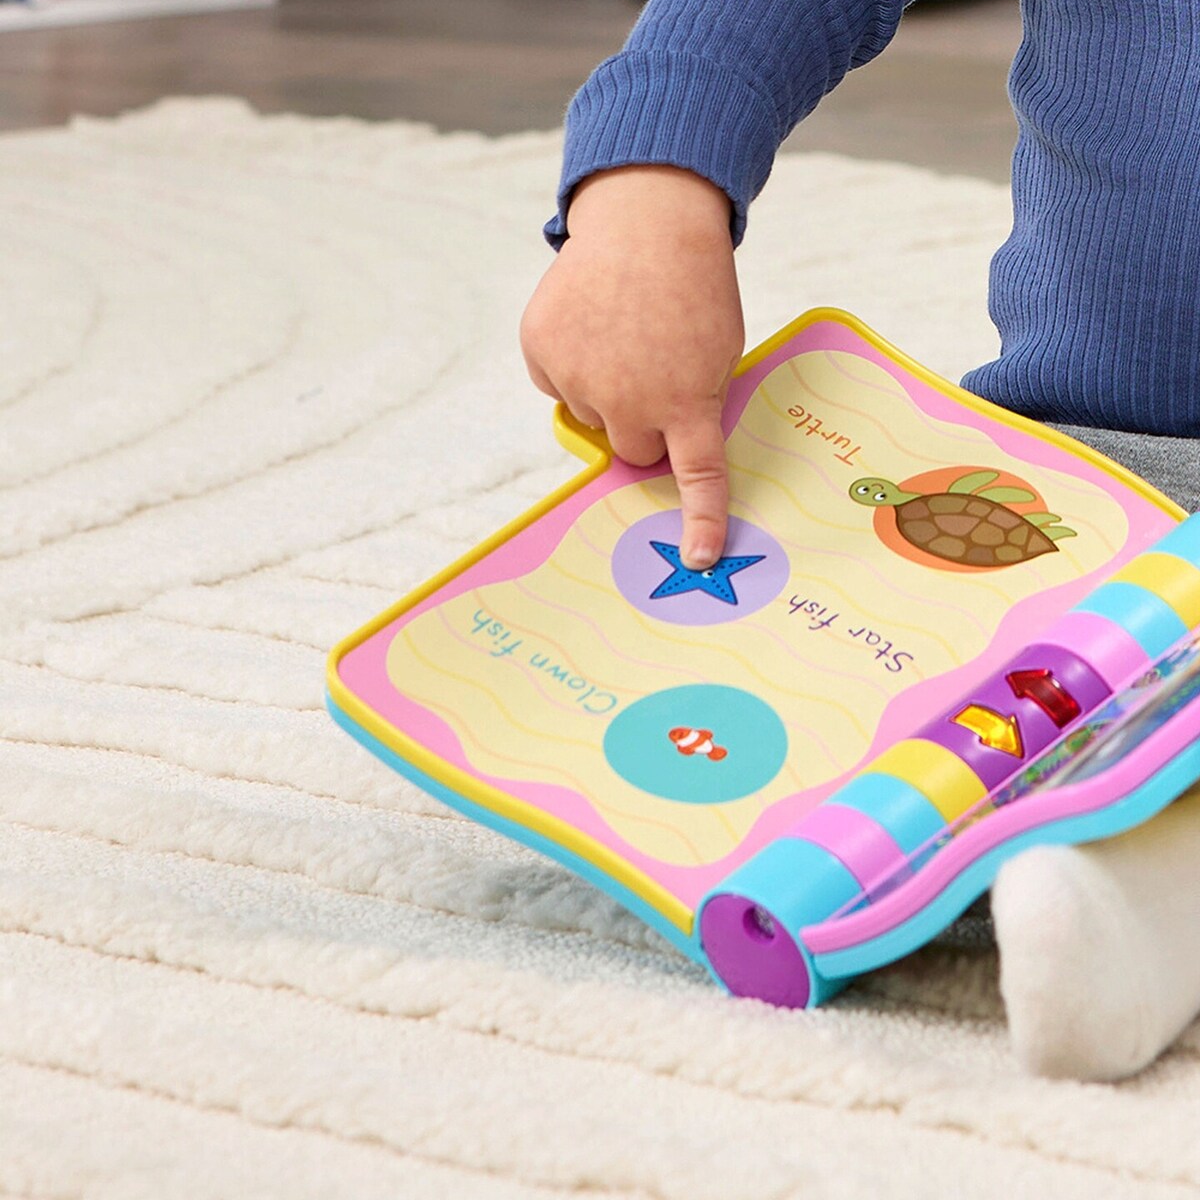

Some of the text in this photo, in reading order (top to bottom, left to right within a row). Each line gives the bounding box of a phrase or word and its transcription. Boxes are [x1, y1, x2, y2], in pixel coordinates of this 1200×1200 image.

[787, 404, 862, 467] Turtle
[470, 608, 618, 715] Clown fish
[788, 594, 915, 673] Star fish
